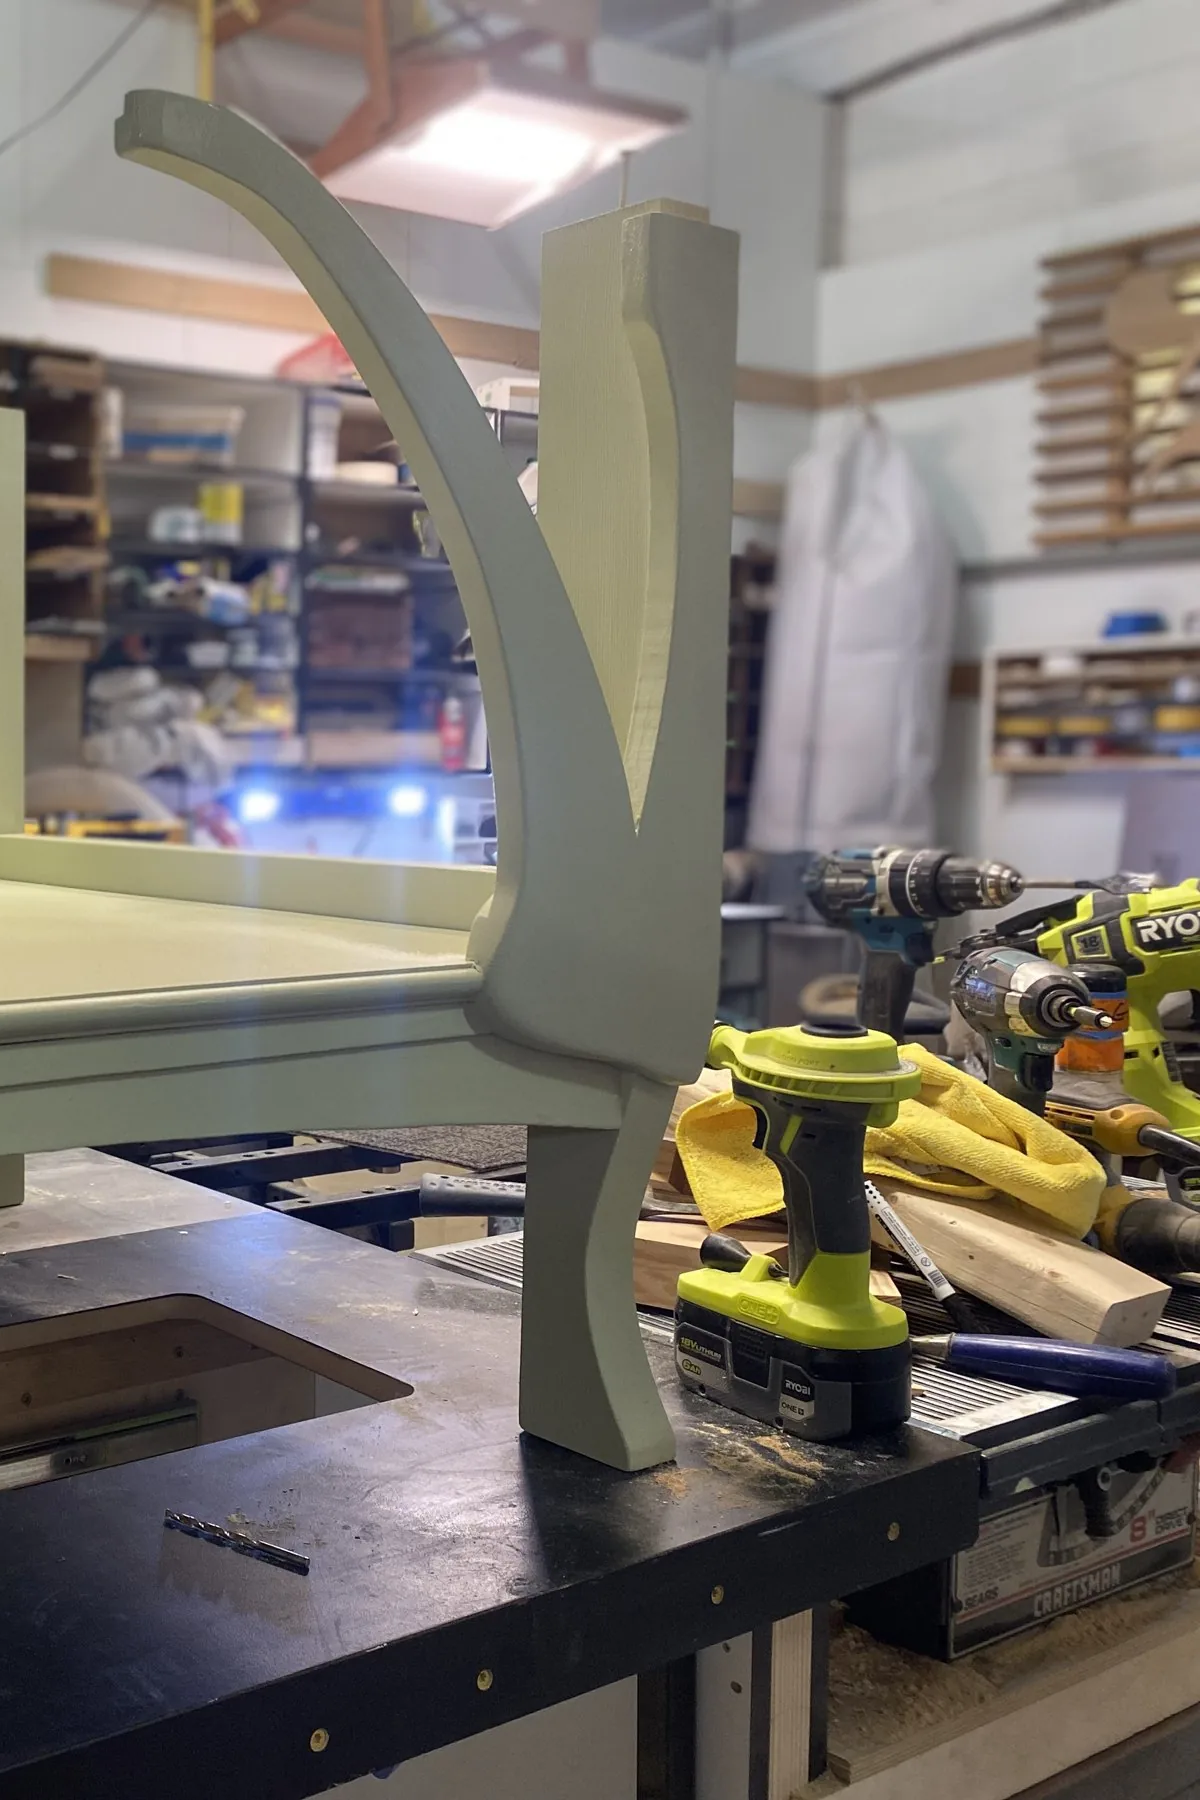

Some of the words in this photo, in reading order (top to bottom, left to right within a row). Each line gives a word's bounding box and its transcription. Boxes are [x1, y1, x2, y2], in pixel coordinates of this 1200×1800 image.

[1137, 911, 1200, 943] RYO
[785, 1379, 811, 1396] RYOBI
[964, 1586, 999, 1610] SEARS
[1034, 1562, 1122, 1618] CRAFTSMAN
